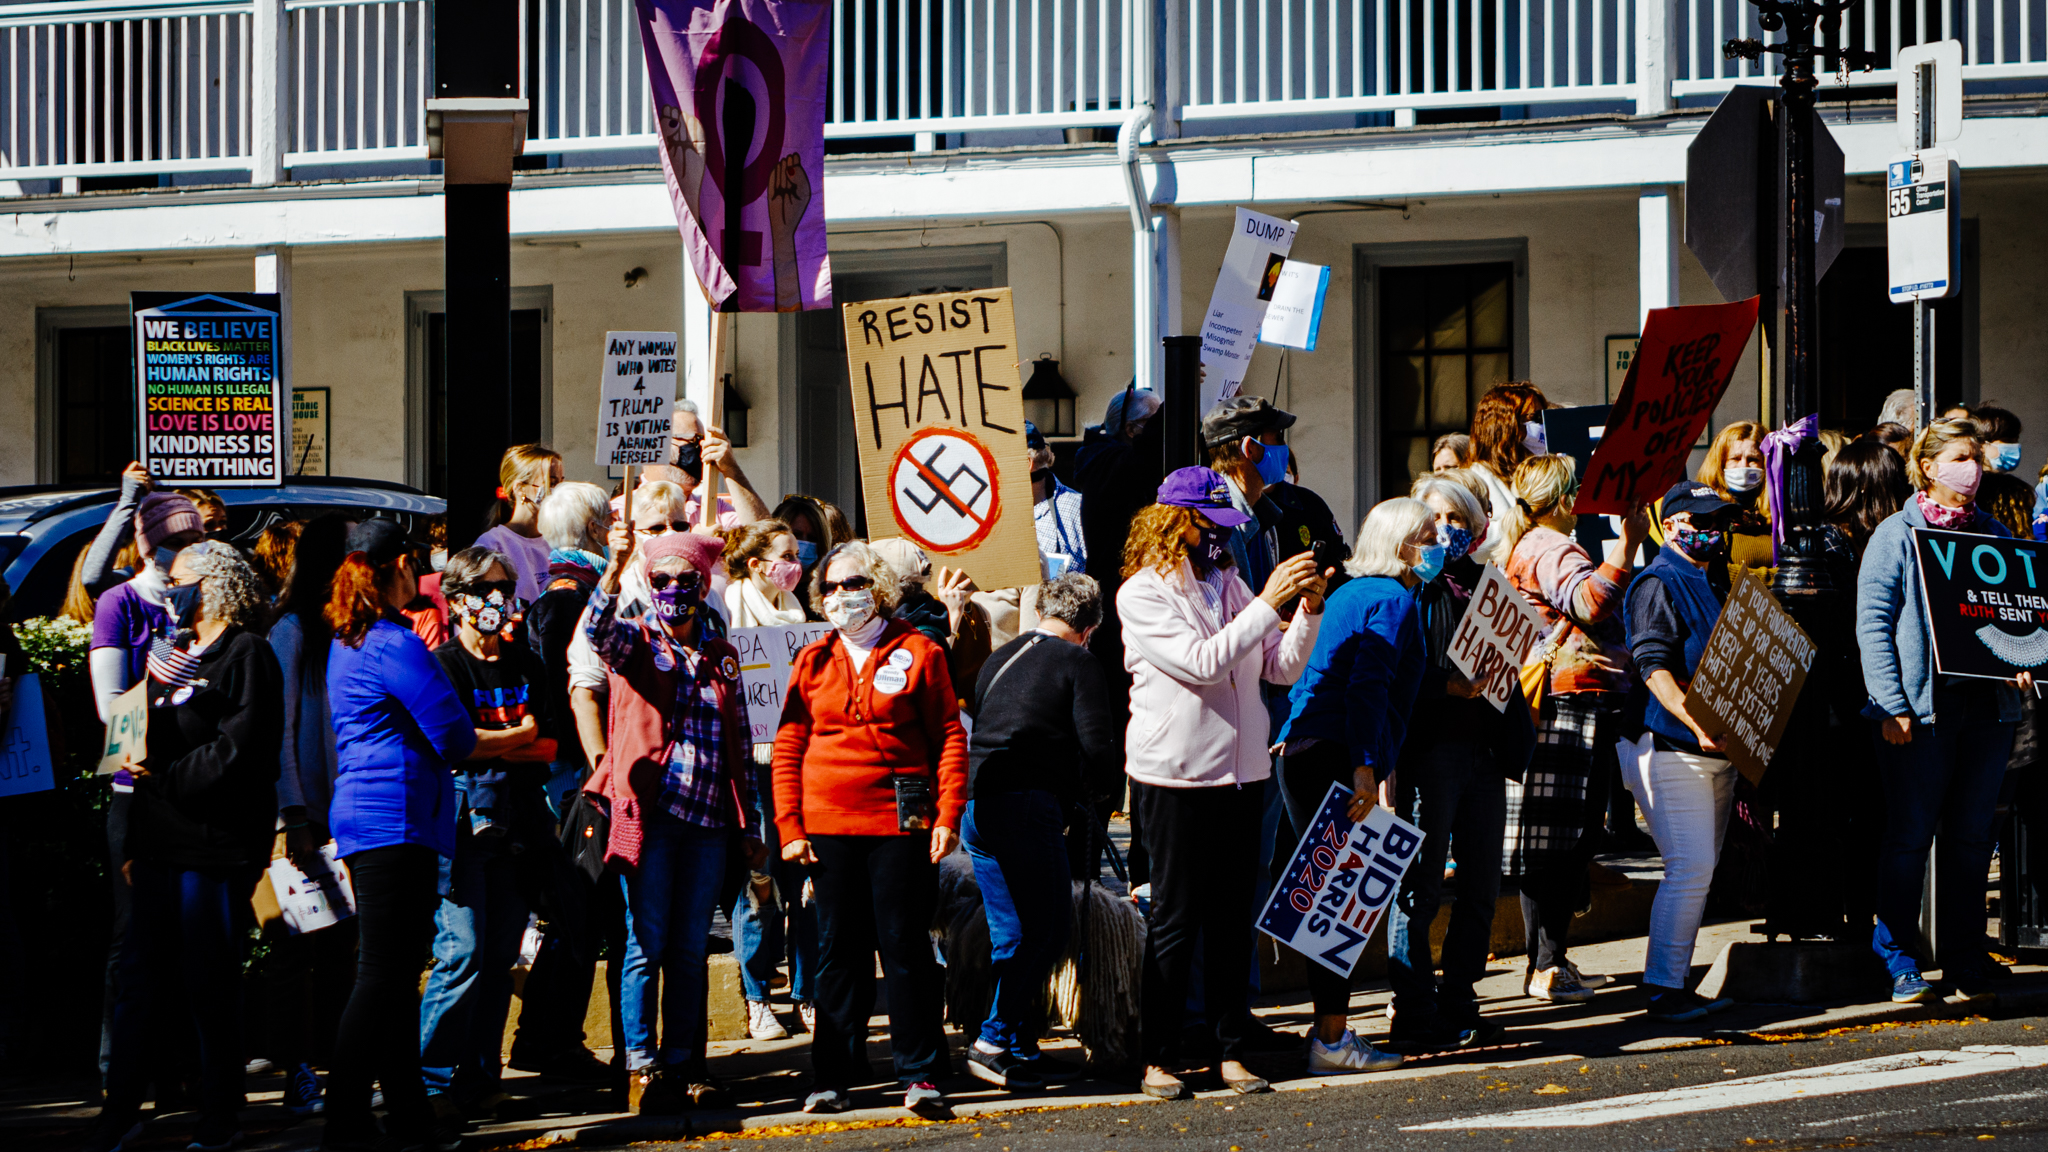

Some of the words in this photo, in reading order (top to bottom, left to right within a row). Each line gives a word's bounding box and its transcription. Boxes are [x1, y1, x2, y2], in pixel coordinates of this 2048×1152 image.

[1890, 188, 1911, 217] 55
[1246, 218, 1285, 242] DUMP
[145, 321, 180, 339] WE
[184, 321, 270, 339] BELIEVE
[858, 297, 1000, 348] RESIST
[146, 341, 187, 352] BLACK
[188, 341, 220, 352] LIVES
[223, 341, 270, 352] MATTER
[608, 338, 635, 356] ANY
[638, 340, 677, 356] WOMAN
[1203, 343, 1224, 356] Swamp
[1617, 351, 1629, 360] TO
[1662, 333, 1721, 378] KEEP
[146, 354, 203, 365] WOMEN'S
[204, 354, 246, 365] RIGHTS
[248, 354, 270, 365] ARE
[617, 360, 643, 376] WHO
[648, 359, 677, 373] VOTES
[147, 366, 210, 381] HUMAN
[213, 366, 272, 381] RIGHTS
[1673, 357, 1721, 393] YOUR
[147, 384, 165, 395] NO
[167, 384, 211, 395] HUMAN
[213, 384, 224, 395] IS
[226, 384, 272, 395] ILLEGAL
[633, 375, 646, 395] 4
[148, 397, 213, 412] SCIENCE
[215, 397, 230, 412] IS
[233, 397, 273, 412] REAL
[609, 396, 664, 417] TRUMP
[864, 344, 1018, 451] HATE
[1632, 379, 1720, 430] POLICIES
[149, 414, 198, 431] LOVE
[202, 414, 219, 431] IS
[223, 414, 273, 431] LOVE
[606, 422, 619, 437] IS
[625, 419, 671, 435] VOTING
[149, 435, 250, 454] KINDNESS
[254, 435, 273, 454] IS
[617, 435, 667, 450] AGAINST
[1643, 420, 1692, 456] OFF
[149, 457, 274, 476] EVERYTHING
[610, 450, 662, 465] HERSELF
[1593, 459, 1653, 501] MY
[653, 598, 688, 617] Vote
[1966, 589, 1978, 603] &
[1980, 590, 2012, 606] TELL
[1476, 578, 1539, 665] BIDEN
[1959, 603, 1995, 619] RUTH
[1998, 607, 2033, 623] SENT
[1737, 577, 1750, 598] IF
[1748, 585, 1769, 622] YOUR
[1764, 605, 1816, 673] FUNDAMENTALS
[1724, 598, 1745, 631] ARE
[1742, 617, 1756, 642] UP
[1752, 626, 1771, 655] FOR
[1768, 644, 1796, 685] GRABS
[1454, 617, 1519, 703] HARRIS
[1713, 623, 1743, 667] EVERY
[1742, 653, 1755, 681] 4
[1751, 662, 1782, 713] YEARS,
[876, 674, 905, 683] Ullman
[473, 683, 530, 708] FUCK
[1704, 646, 1731, 688] THAT'S
[1728, 676, 1740, 700] A
[1737, 684, 1774, 736] SYSTEM
[1712, 695, 1733, 722] NOT
[1726, 709, 1738, 728] A
[1734, 714, 1758, 757] VOTING
[1756, 741, 1775, 767] ONE
[1289, 819, 1349, 913] 2020
[1307, 824, 1381, 937] HARRIS
[1319, 823, 1420, 972] BIDEN
